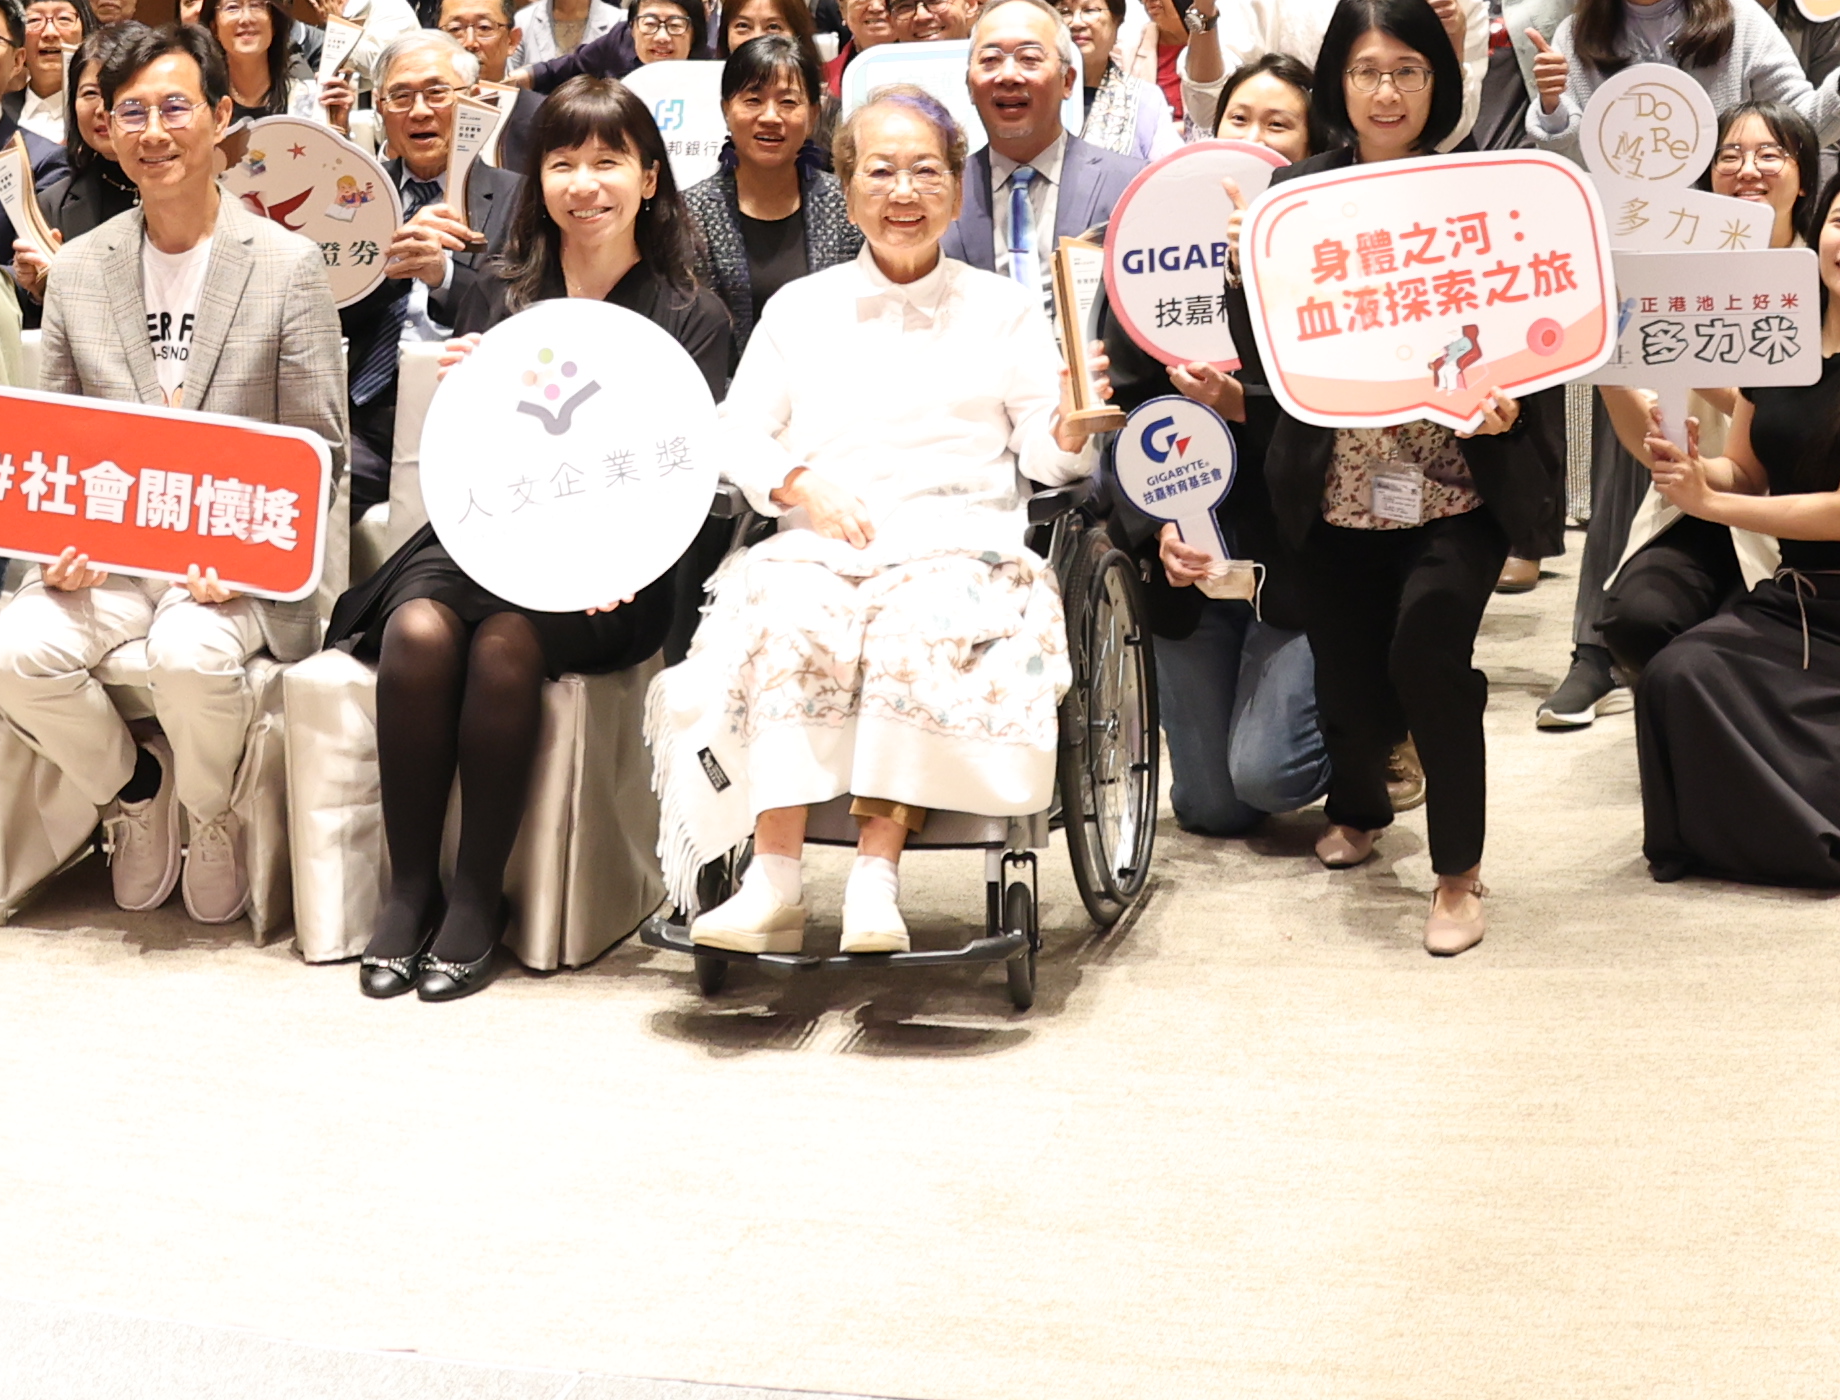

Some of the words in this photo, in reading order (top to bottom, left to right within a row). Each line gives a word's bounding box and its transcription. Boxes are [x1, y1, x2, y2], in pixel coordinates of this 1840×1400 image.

[1635, 92, 1673, 122] Do
[1650, 126, 1690, 160] Re
[1310, 209, 1525, 285] 身體之河：
[1614, 197, 1753, 250] 多力米
[1296, 250, 1578, 342] 血液探索之旅
[1640, 293, 1800, 314] 正港池上好米
[1639, 314, 1801, 365] 多力米
[457, 435, 695, 525] 人文企業獎
[1143, 467, 1223, 505] 技嘉教育基金會
